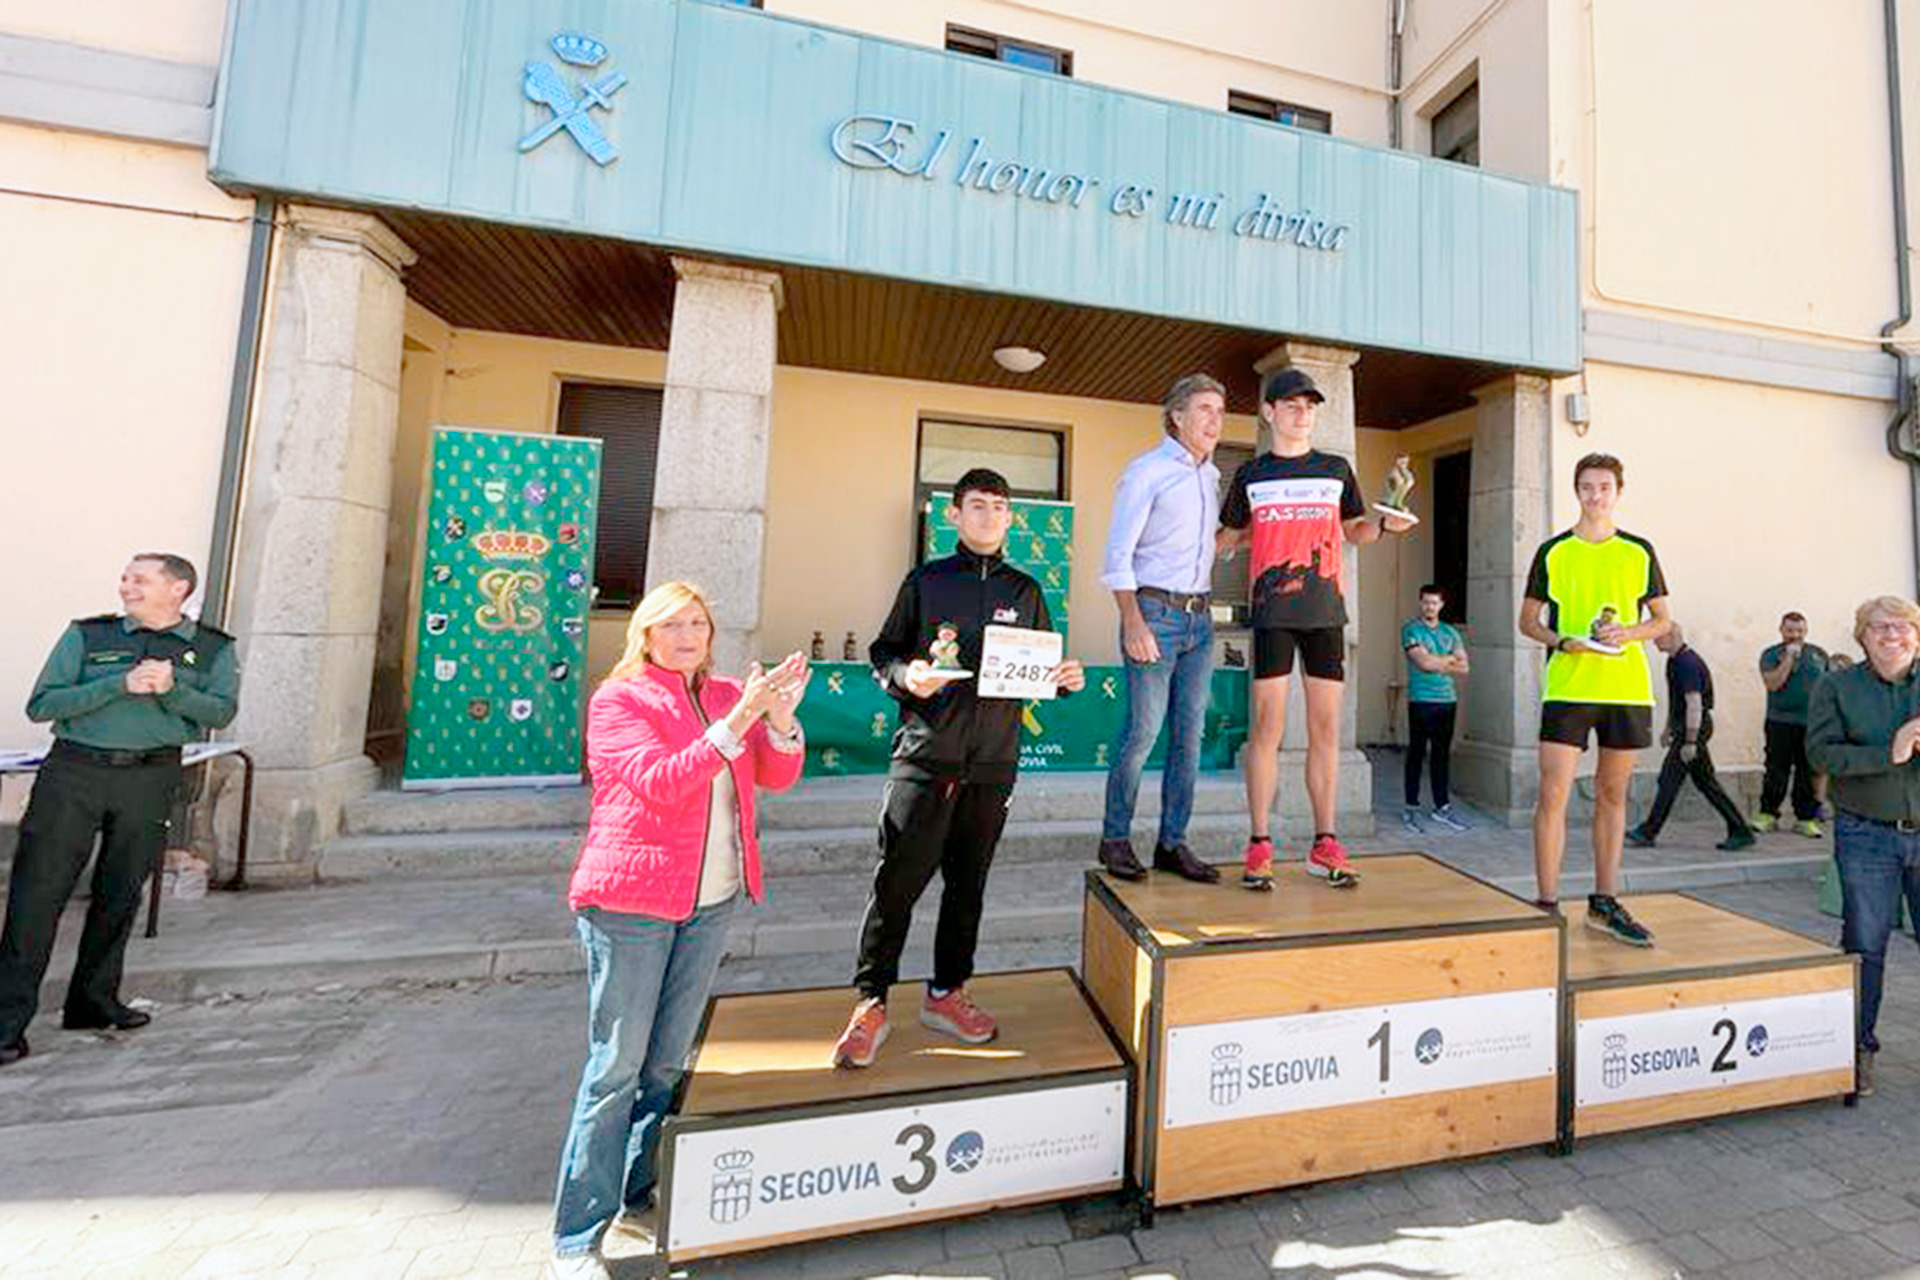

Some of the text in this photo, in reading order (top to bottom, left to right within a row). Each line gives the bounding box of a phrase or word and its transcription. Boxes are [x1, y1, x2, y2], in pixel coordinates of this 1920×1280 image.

[831, 114, 1350, 252] El honor es mi divisa
[1004, 661, 1054, 682] 2487
[1248, 1020, 1391, 1090] SEGOVIA 1
[1630, 1046, 1700, 1075] SEGOVIA
[1710, 1018, 1738, 1073] 2
[759, 1123, 938, 1204] SEGOVIA 3
